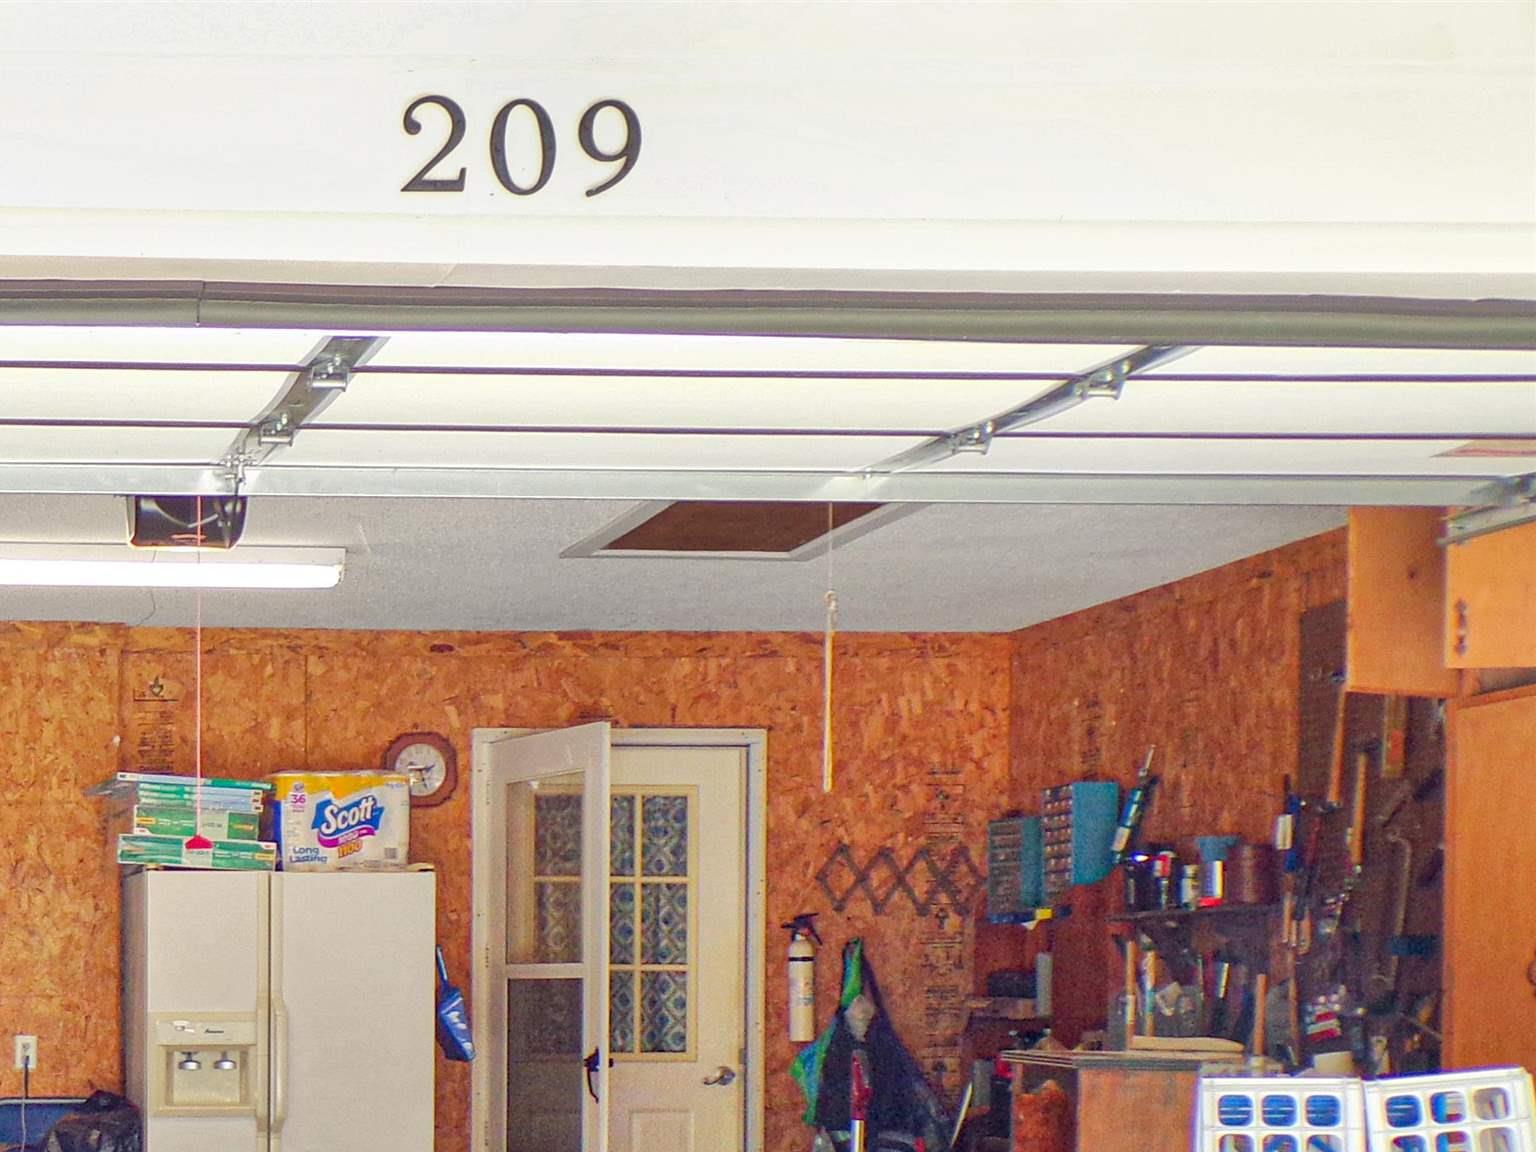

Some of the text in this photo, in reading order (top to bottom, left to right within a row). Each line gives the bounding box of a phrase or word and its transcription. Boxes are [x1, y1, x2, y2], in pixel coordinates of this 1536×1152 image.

[400, 94, 642, 197] 209
[290, 793, 306, 804] 36
[321, 796, 375, 835] Scott
[292, 846, 320, 855] Long
[289, 854, 328, 865] Lasting
